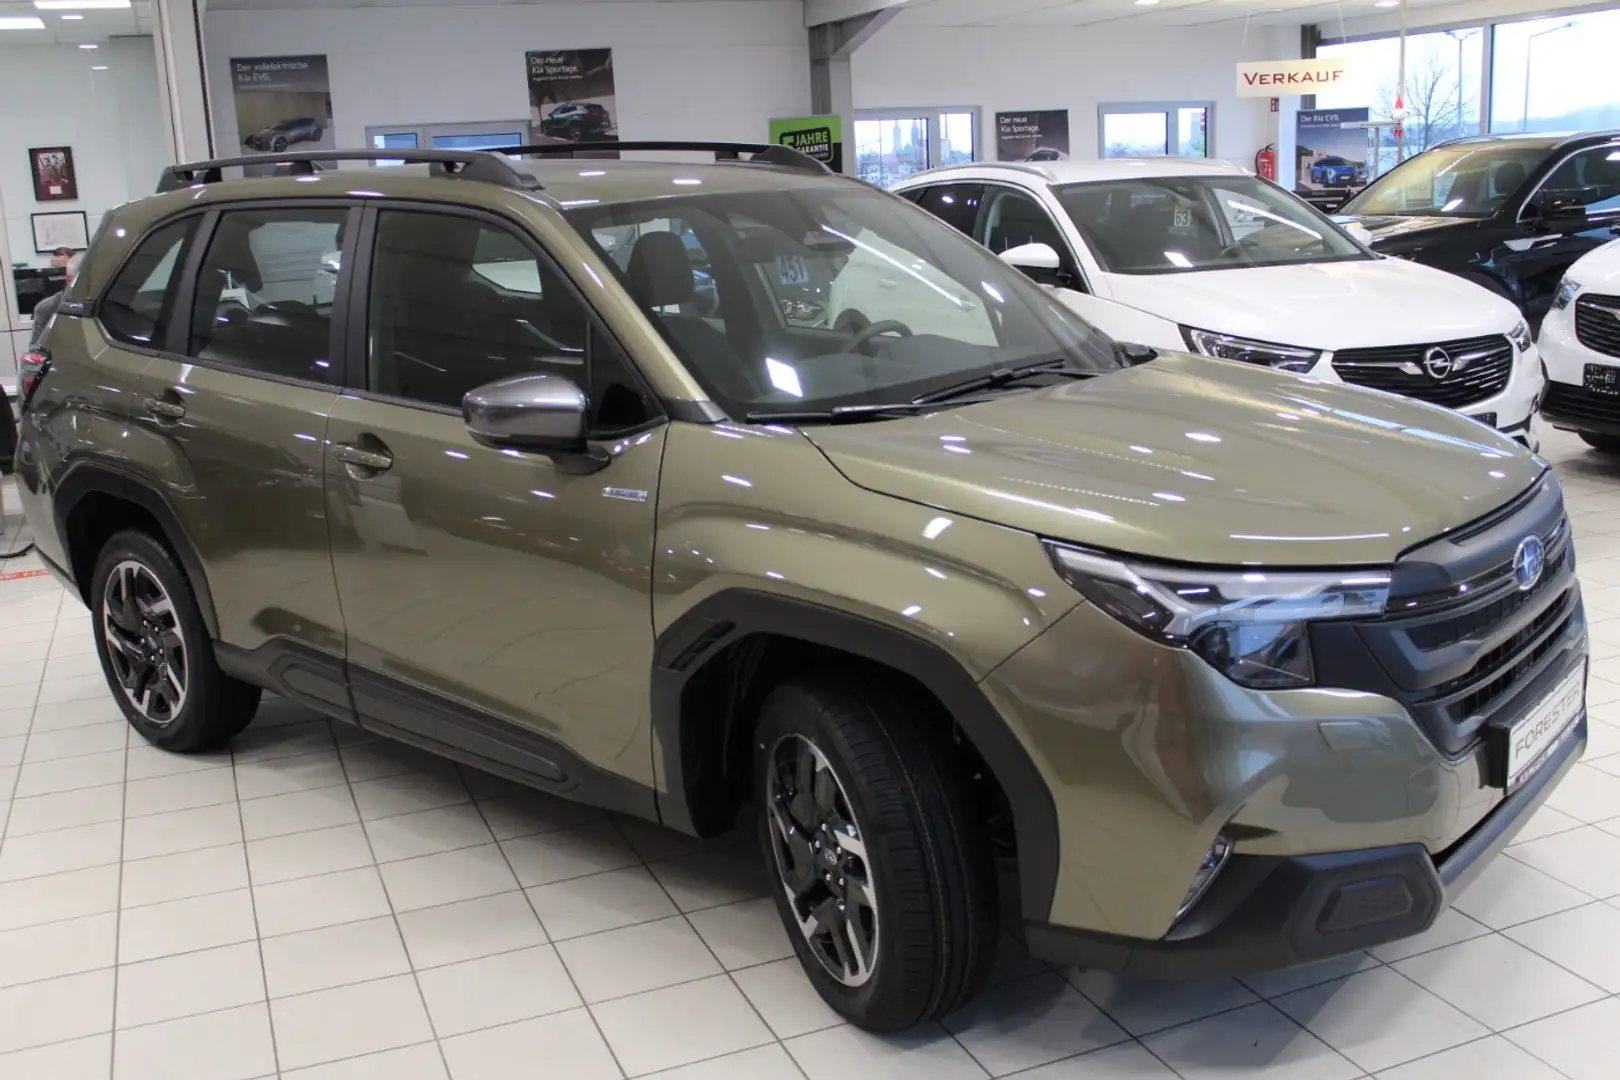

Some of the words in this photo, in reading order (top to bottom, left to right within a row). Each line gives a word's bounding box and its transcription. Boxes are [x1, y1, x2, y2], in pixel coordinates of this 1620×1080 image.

[236, 64, 251, 72] Der
[532, 66, 544, 74] Kia
[238, 74, 251, 82] Kia
[1243, 70, 1344, 86] VERKAUF
[795, 132, 828, 147] JAHRE
[1176, 210, 1189, 225] 63
[1514, 686, 1581, 760] FORESTER
